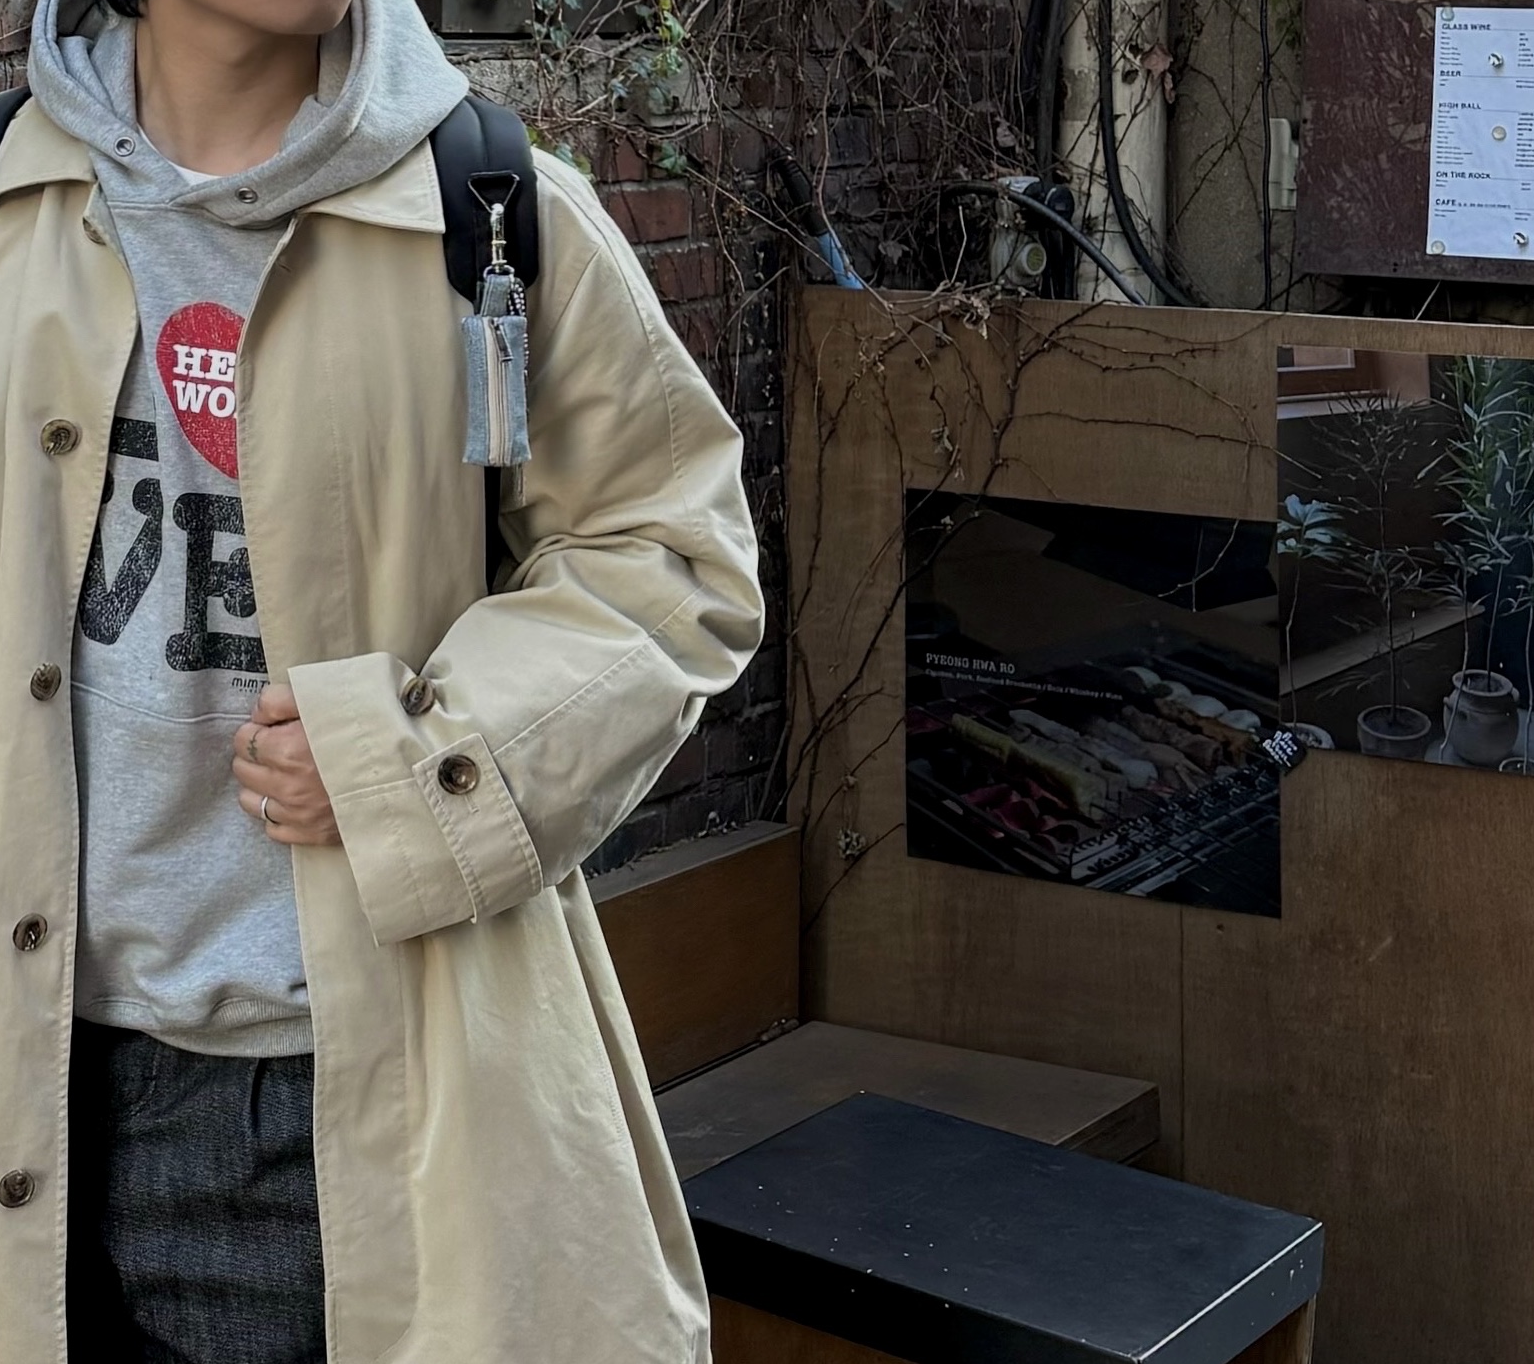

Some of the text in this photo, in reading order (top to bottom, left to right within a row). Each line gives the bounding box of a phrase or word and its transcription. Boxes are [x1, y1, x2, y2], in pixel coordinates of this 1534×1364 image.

[1441, 23, 1468, 31] GLASS
[1438, 102, 1482, 110] HIGH BALL
[1435, 170, 1448, 178] ON
[1450, 171, 1466, 179] THE
[1435, 198, 1456, 206] CAFE
[172, 380, 238, 419] WO
[925, 653, 1016, 675] PYEONG HWA RO
